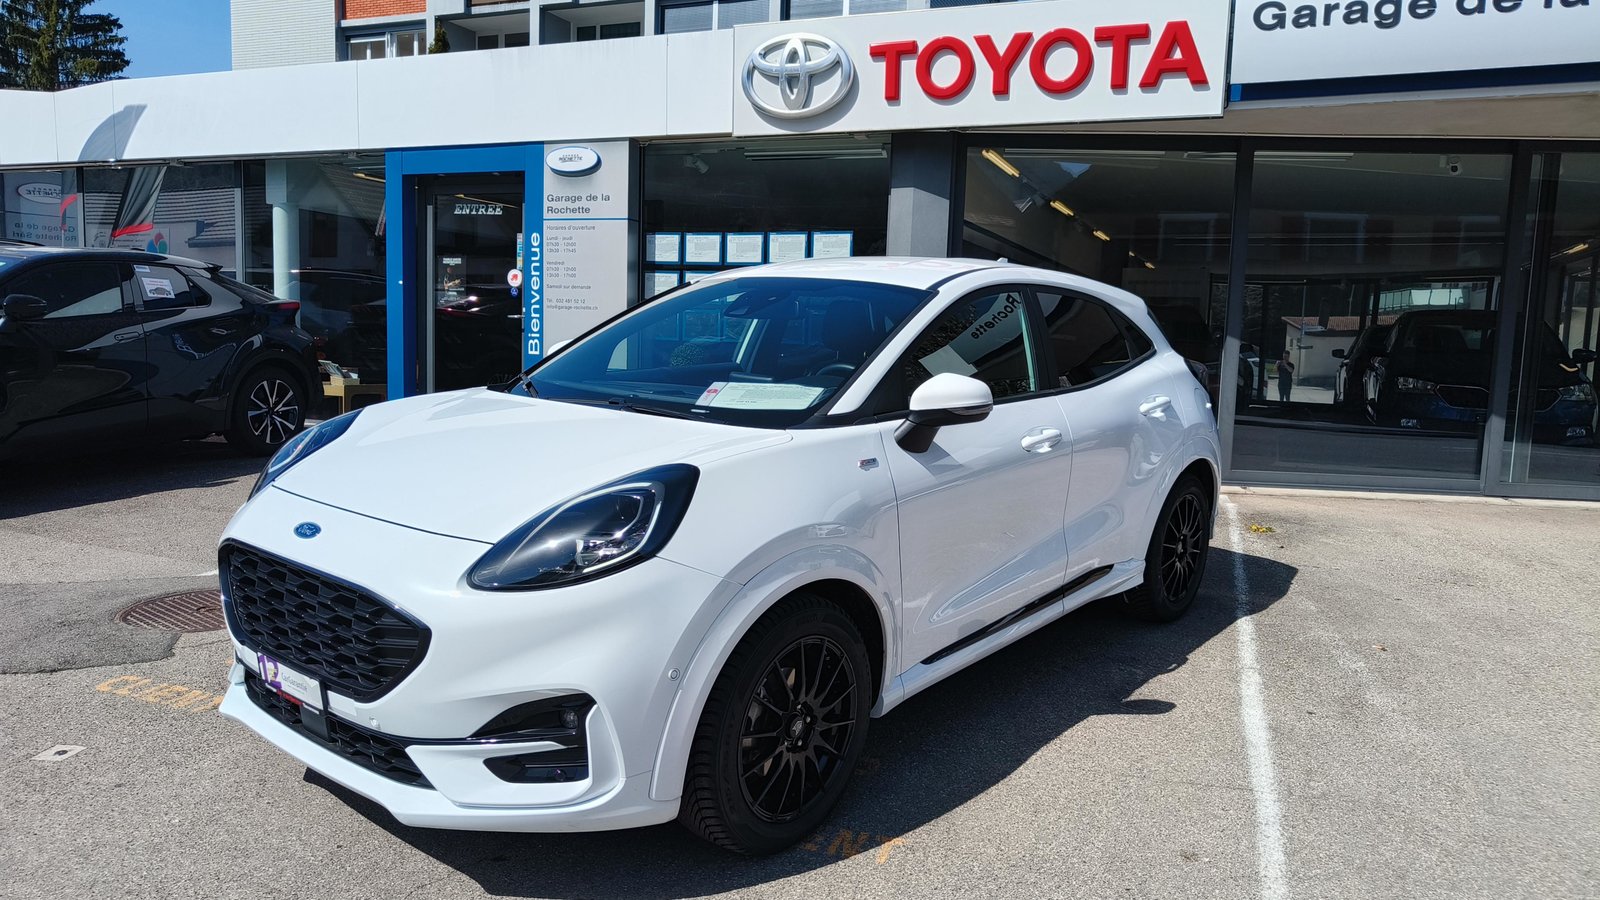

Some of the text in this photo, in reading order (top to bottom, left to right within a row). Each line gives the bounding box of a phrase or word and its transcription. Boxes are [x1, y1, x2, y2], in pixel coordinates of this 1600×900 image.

[1252, 0, 1437, 31] Garage
[869, 20, 1209, 101] TOYOTA
[454, 203, 503, 215] ENTREE
[546, 193, 611, 204] Garage de la
[546, 205, 591, 214] Rochette
[527, 232, 541, 355] Bienvenue
